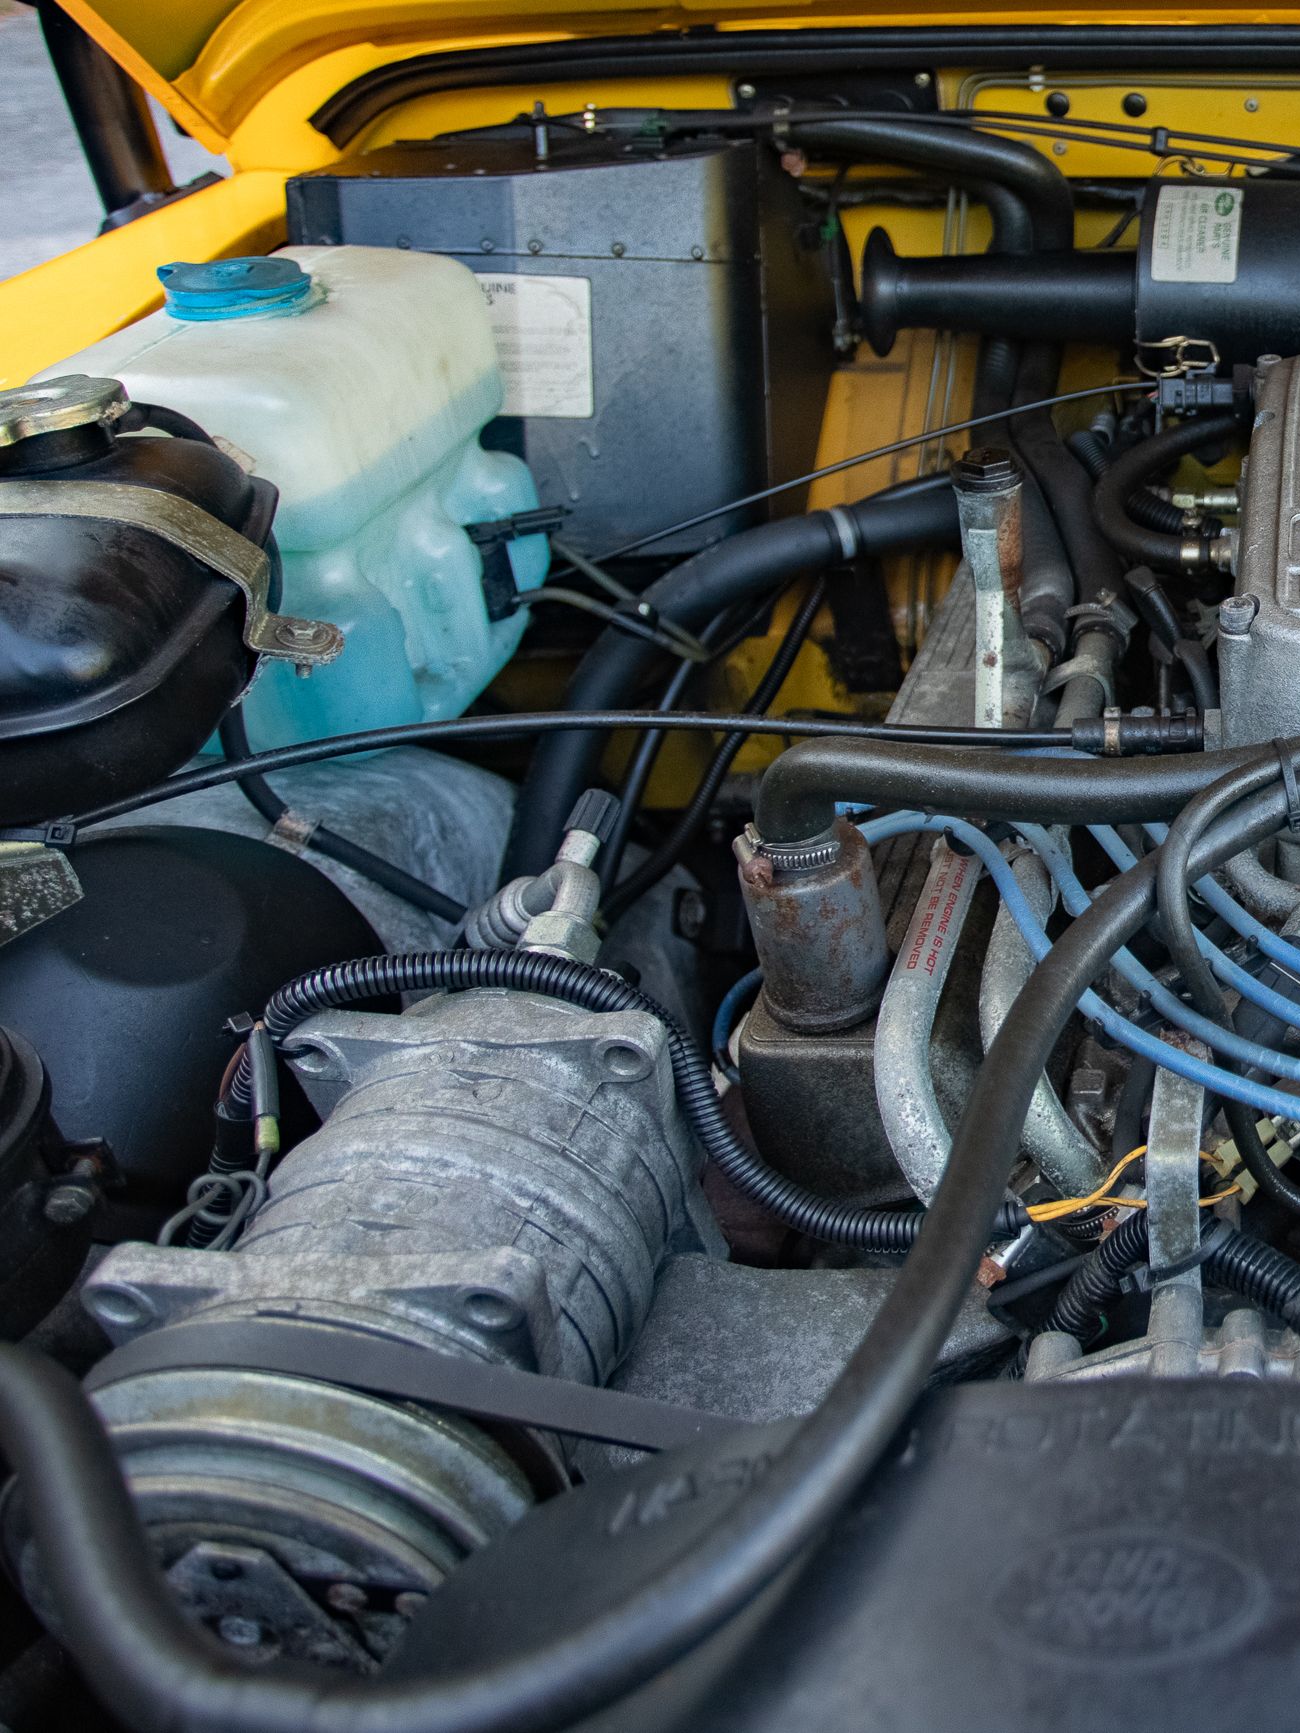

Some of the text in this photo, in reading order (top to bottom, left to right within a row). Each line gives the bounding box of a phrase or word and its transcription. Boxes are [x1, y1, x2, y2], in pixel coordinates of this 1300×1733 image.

[481, 282, 516, 295] UINE
[935, 871, 949, 893] NOT
[928, 896, 939, 910] BE
[924, 858, 969, 976] WHEN ENGINE IS HOT
[907, 912, 934, 970] REMOVED
